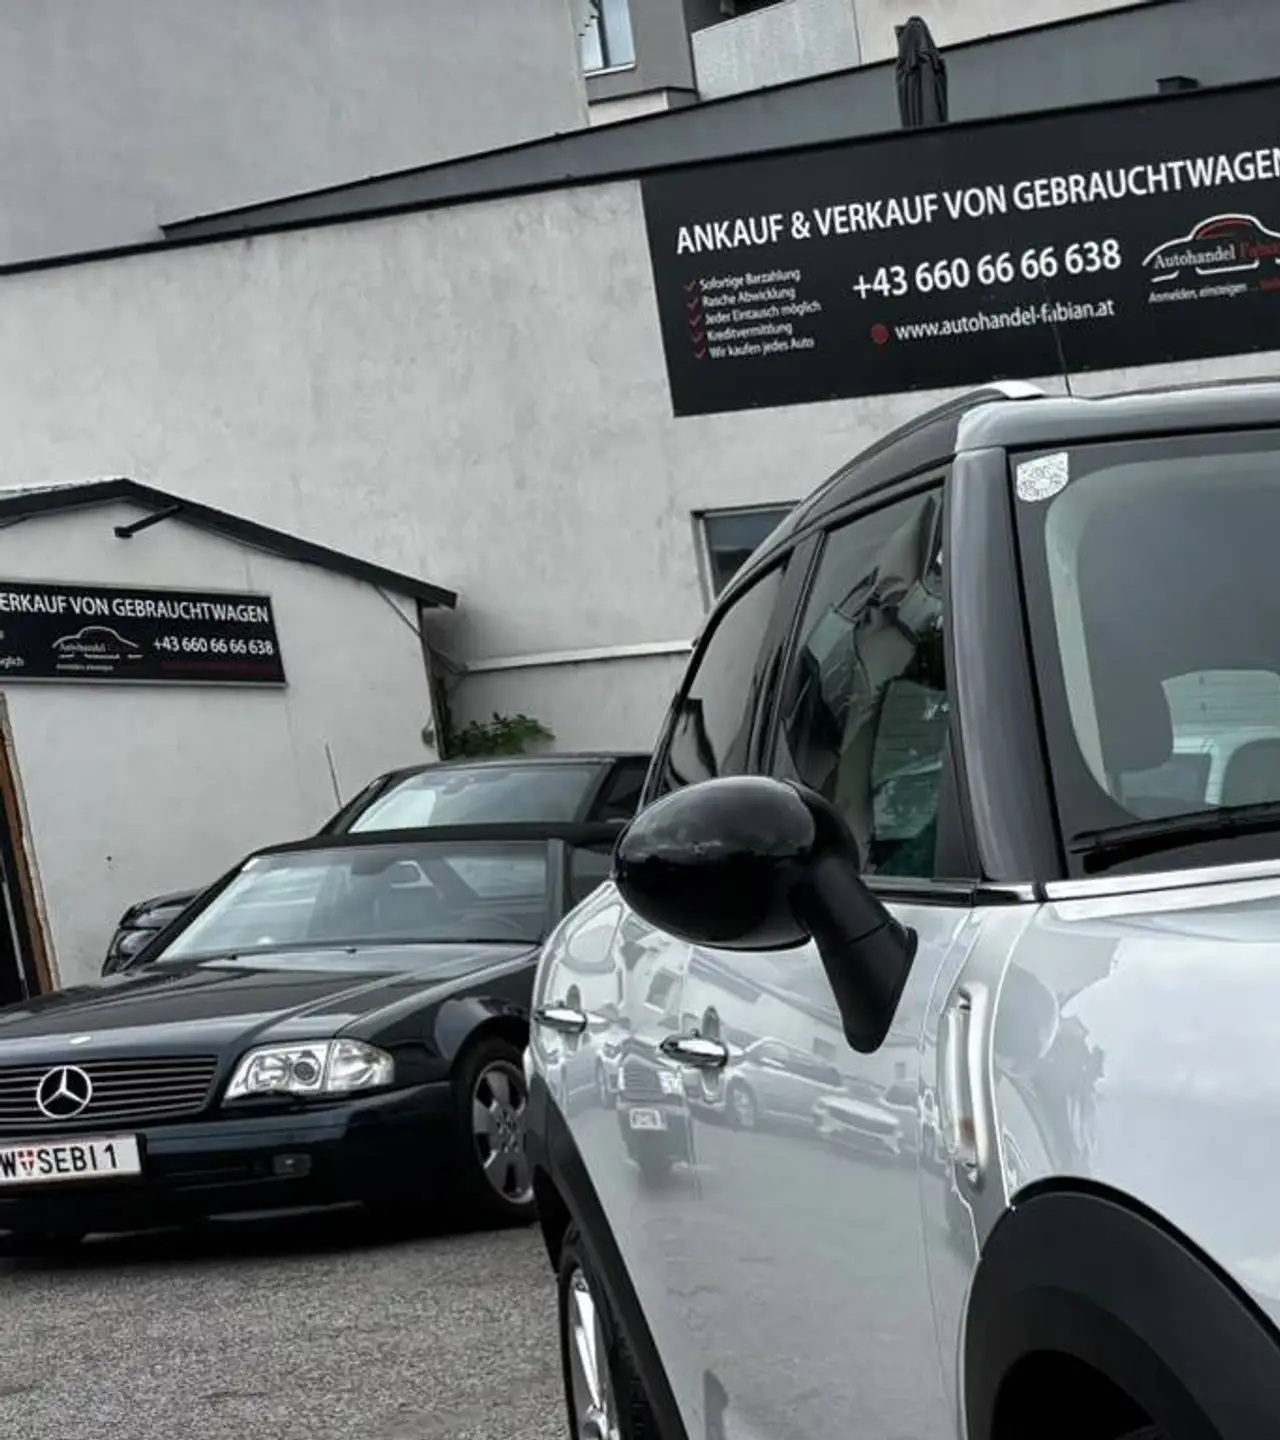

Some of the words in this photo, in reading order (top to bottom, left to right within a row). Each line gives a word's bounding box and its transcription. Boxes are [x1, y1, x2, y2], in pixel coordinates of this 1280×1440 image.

[676, 213, 784, 255] ANKAUF
[790, 210, 811, 240] &
[813, 193, 938, 237] VERKAUF
[943, 184, 1008, 221] VON
[853, 265, 908, 300] +43
[915, 257, 970, 293] 660
[976, 252, 1014, 285] 66
[1020, 246, 1058, 280] 66
[1064, 238, 1121, 275] 638
[1154, 243, 1236, 269] Autohandel
[894, 299, 1115, 340] www.autohandel-fabian.at
[69, 596, 110, 617] VON
[112, 598, 269, 622] GEBRAUCHTWAGEN
[153, 635, 179, 652] +43
[181, 636, 208, 653] 660
[210, 637, 228, 653] 66
[229, 638, 247, 654] 66
[248, 639, 274, 656] 638
[0, 1151, 16, 1178] W
